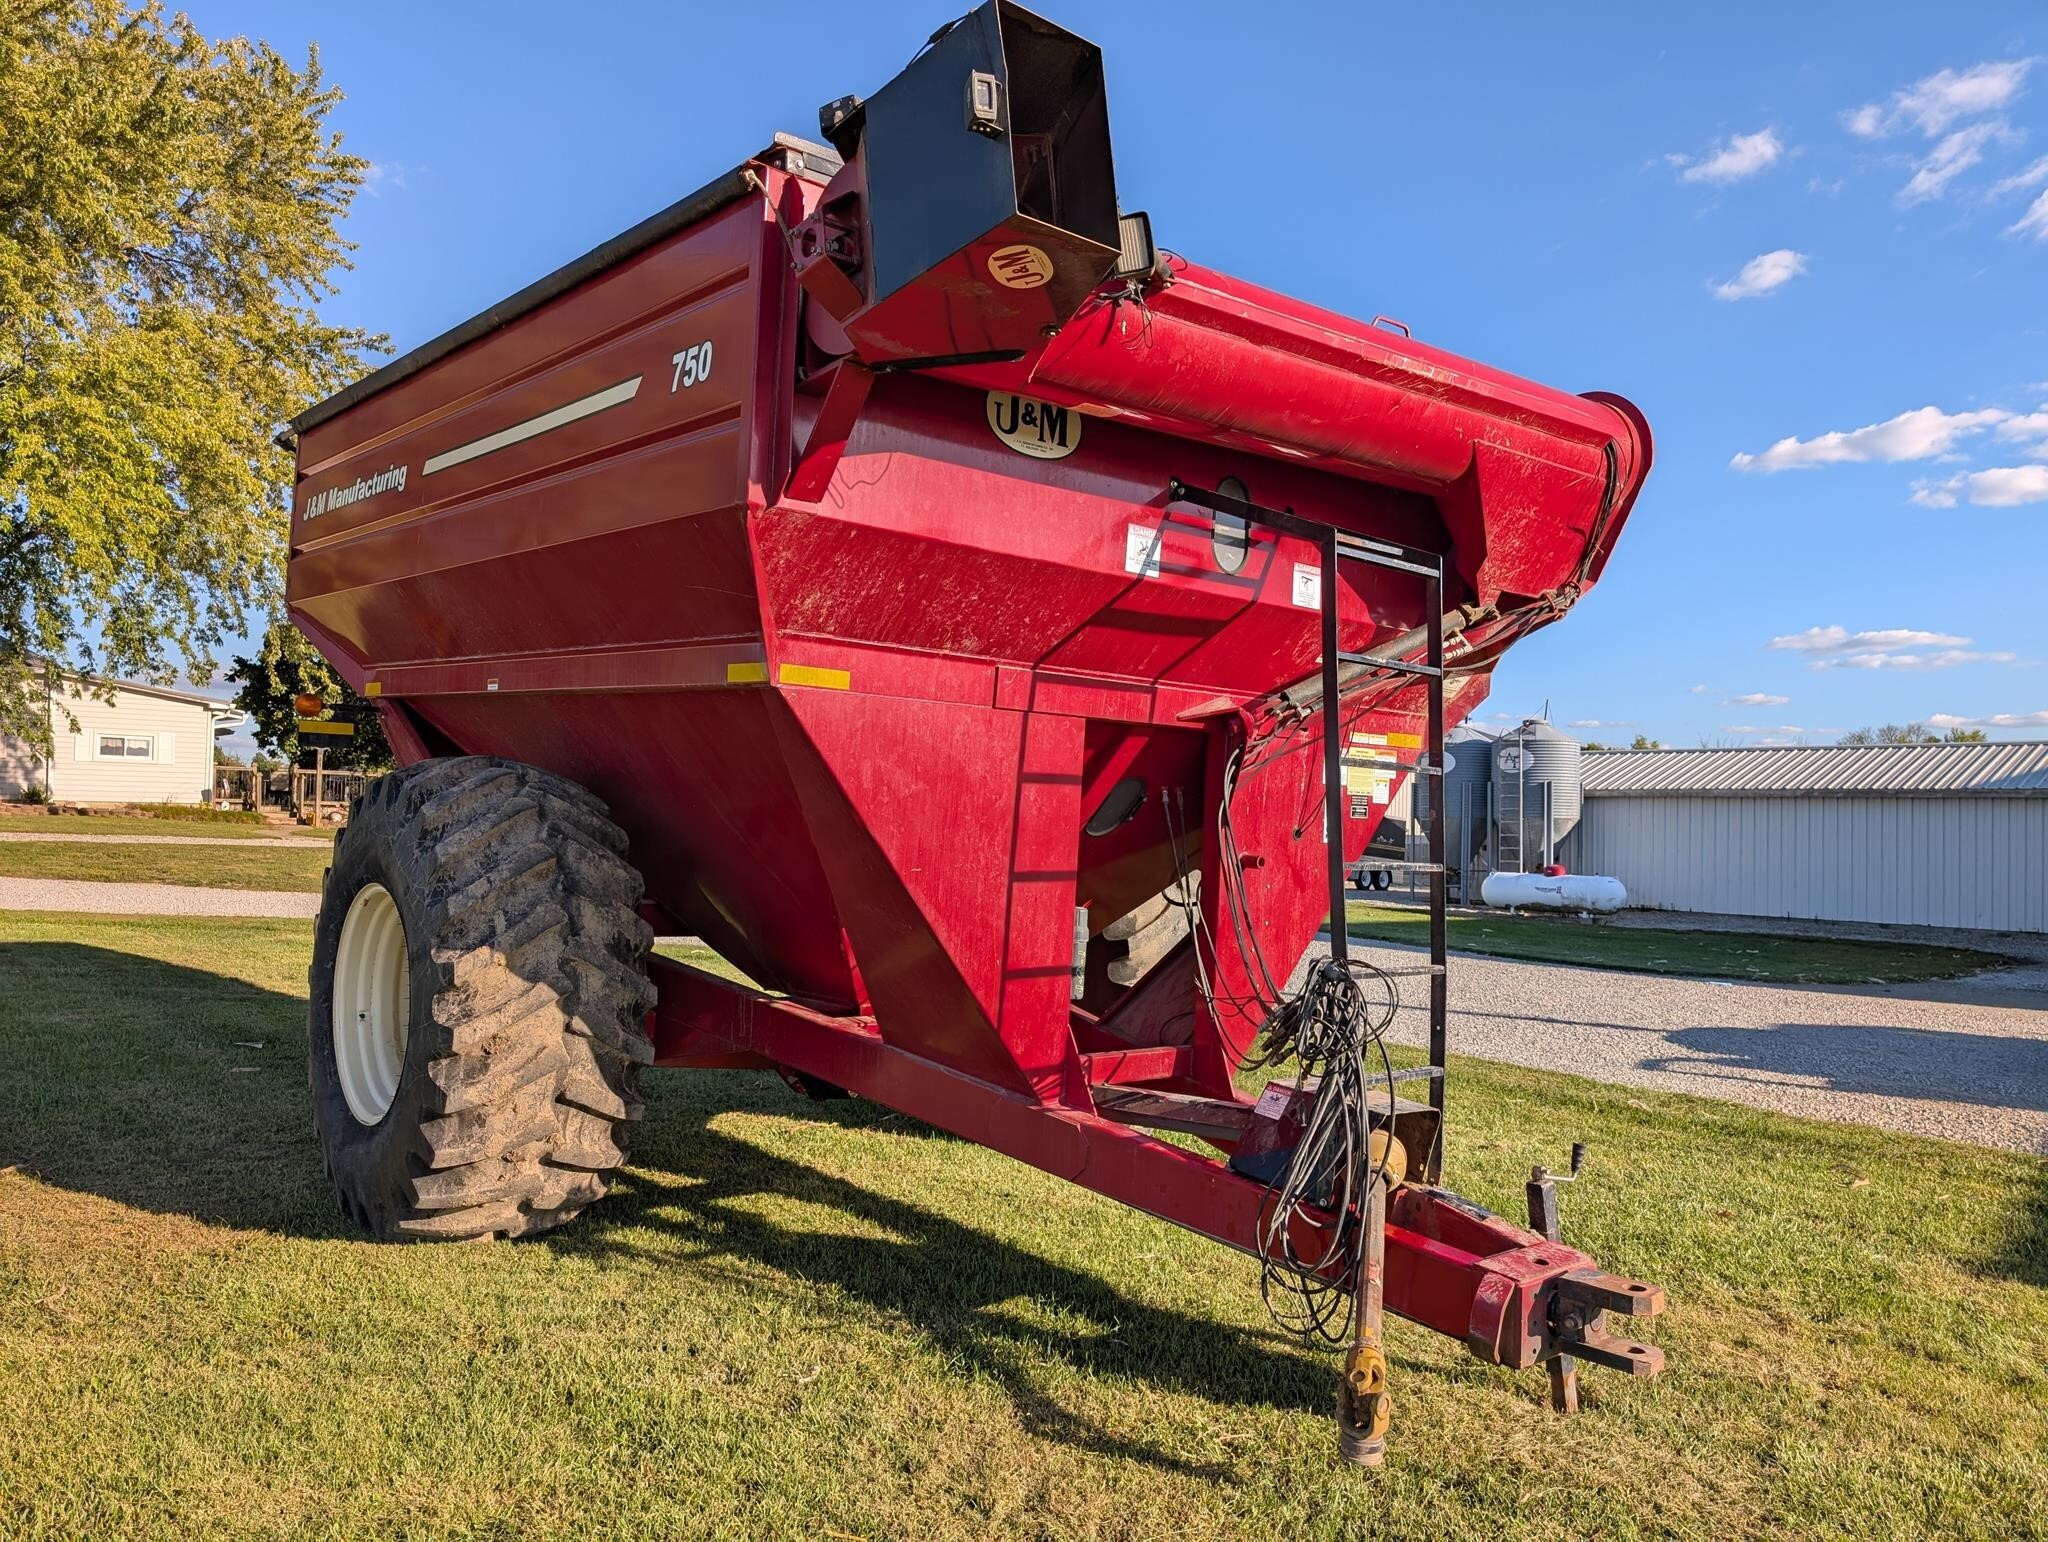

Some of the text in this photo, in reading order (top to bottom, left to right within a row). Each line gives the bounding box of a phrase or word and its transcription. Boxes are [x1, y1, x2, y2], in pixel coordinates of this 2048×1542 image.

[992, 248, 1044, 285] J&M
[671, 340, 713, 393] 750
[994, 395, 1068, 448] J&M
[303, 464, 408, 520] J&M Manufacturing
[1134, 526, 1161, 540] DANGER
